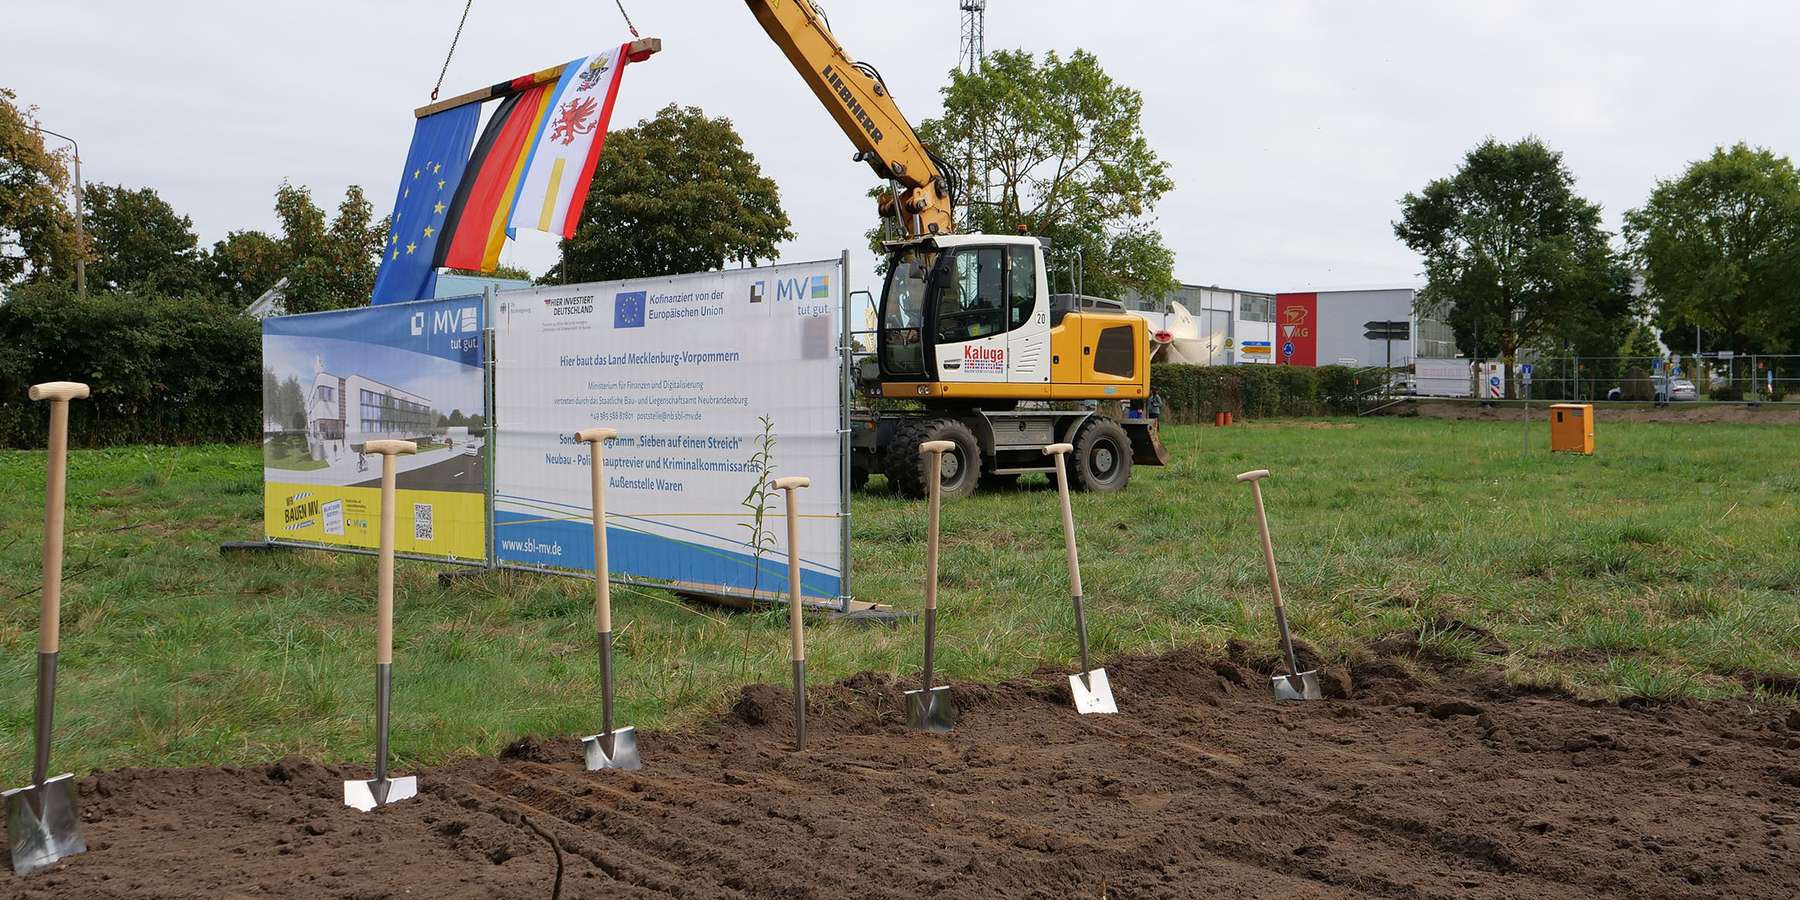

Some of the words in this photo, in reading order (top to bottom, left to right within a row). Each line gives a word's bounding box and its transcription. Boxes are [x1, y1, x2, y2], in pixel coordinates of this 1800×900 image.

[822, 64, 883, 145] LIEBHERR
[777, 277, 808, 301] MV
[551, 298, 563, 306] HIER
[564, 295, 594, 305] INVESTIERT
[649, 293, 693, 304] Kofinanziert
[695, 293, 710, 302] von
[711, 290, 724, 300] der
[553, 305, 594, 316] DEUTSCHLAND
[649, 306, 699, 320] Europäischen
[701, 305, 723, 316] Union
[798, 304, 811, 315] tut
[812, 303, 831, 317] gut.
[434, 308, 461, 335] MV
[1037, 313, 1046, 324] 20
[451, 339, 462, 350] tut
[463, 338, 479, 352] gut.
[560, 355, 576, 366] Hier
[576, 354, 593, 366] baut
[594, 353, 607, 366] das
[608, 352, 626, 365] Land
[628, 351, 739, 366] Mecklenburg-Vorpommern
[964, 345, 1004, 362] Kaluga
[618, 380, 626, 390] für
[627, 380, 650, 389] Finanzen
[651, 380, 662, 389] und
[663, 380, 704, 391] Digitalisierung
[638, 396, 647, 405] und
[649, 395, 696, 406] Liegenschaftsamt
[698, 395, 749, 406] Neubrandenburg
[637, 434, 666, 449] „Sieben
[668, 435, 681, 448] auf
[682, 435, 706, 449] einen
[545, 453, 572, 465] Neubau
[645, 457, 660, 469] und
[663, 457, 760, 473] Kriminalkommissariat
[609, 476, 655, 490] Außenstelle
[656, 479, 683, 491] Waren
[285, 504, 307, 523] BAUEN
[502, 538, 562, 556] www.sbl-mv.de
